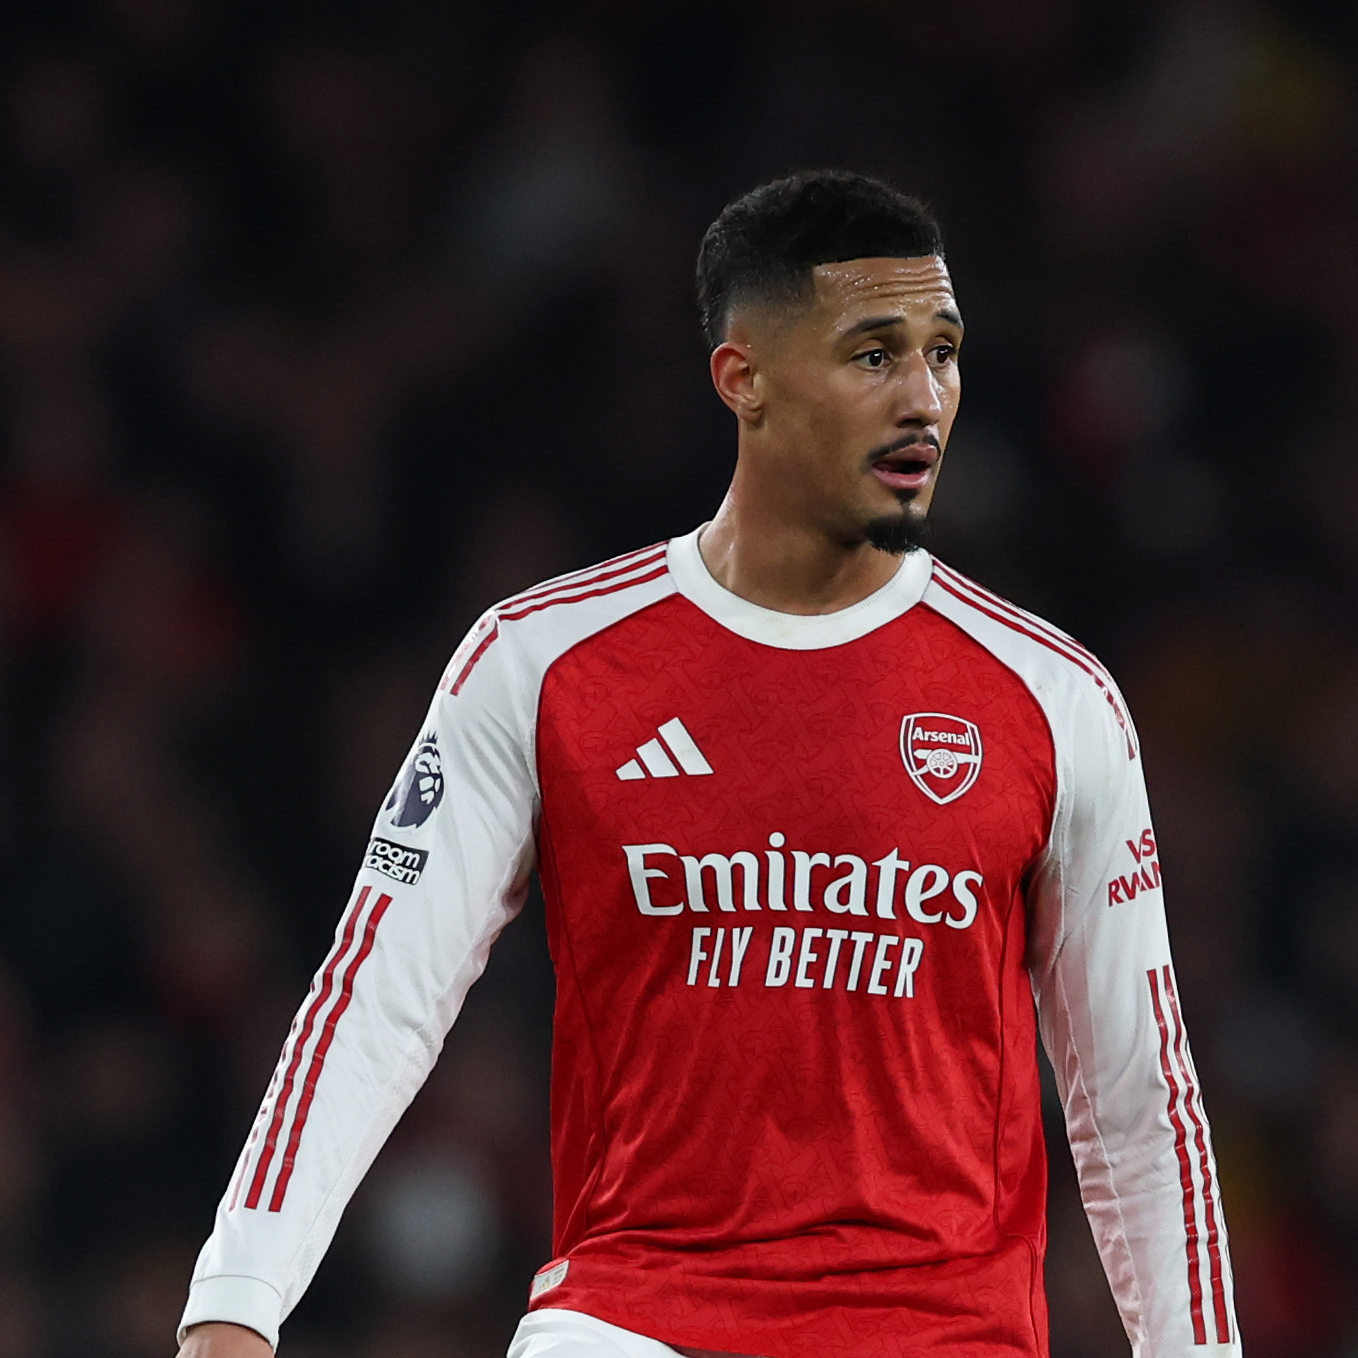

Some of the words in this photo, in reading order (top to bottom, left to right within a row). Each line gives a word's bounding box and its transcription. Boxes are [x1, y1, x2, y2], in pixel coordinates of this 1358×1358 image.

[912, 726, 971, 746] Arsenal
[370, 841, 420, 868] room
[365, 855, 420, 884] acism
[621, 832, 984, 930] Emirates
[686, 926, 753, 988] FLY
[764, 926, 924, 999] BETTER
